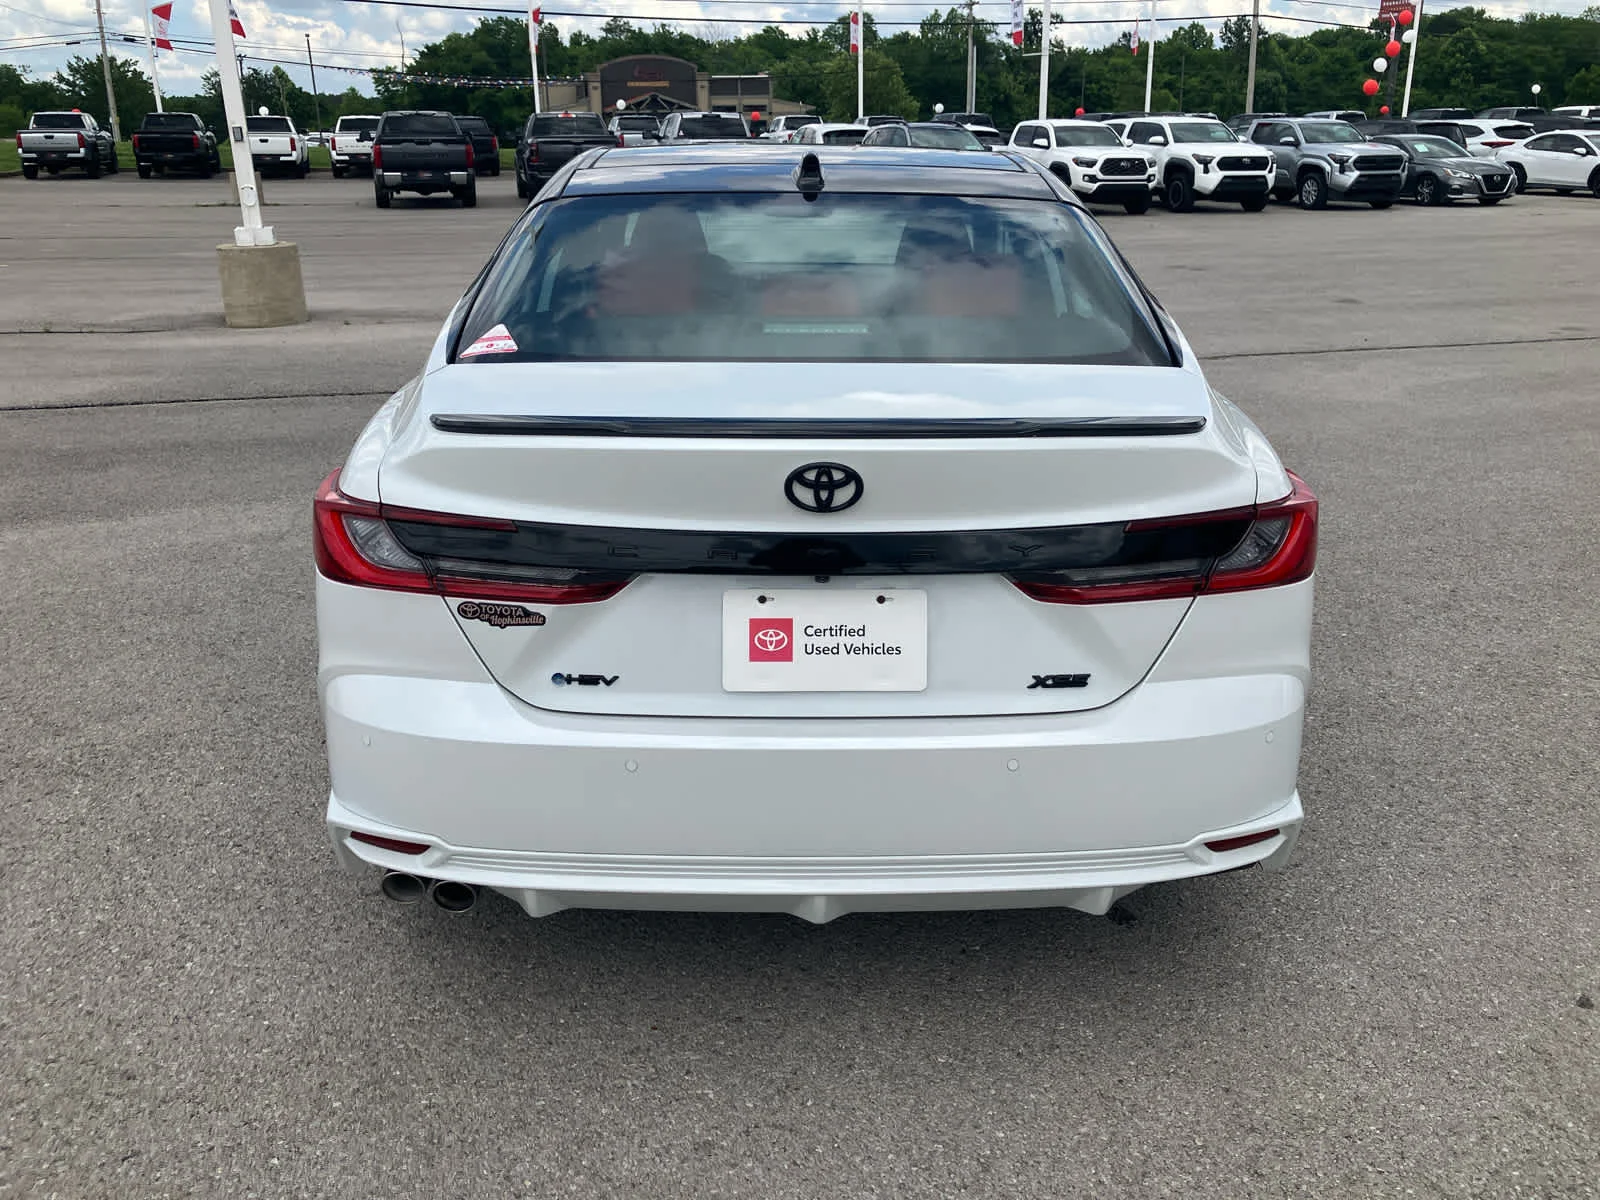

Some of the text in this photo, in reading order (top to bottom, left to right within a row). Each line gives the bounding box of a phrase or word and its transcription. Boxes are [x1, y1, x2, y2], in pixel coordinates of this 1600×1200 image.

[480, 604, 525, 616] TOYOTA
[490, 614, 545, 627] Hopkinsville
[804, 625, 865, 637] Certified
[804, 643, 902, 655] Used Vehicles
[1026, 673, 1092, 688] XSE
